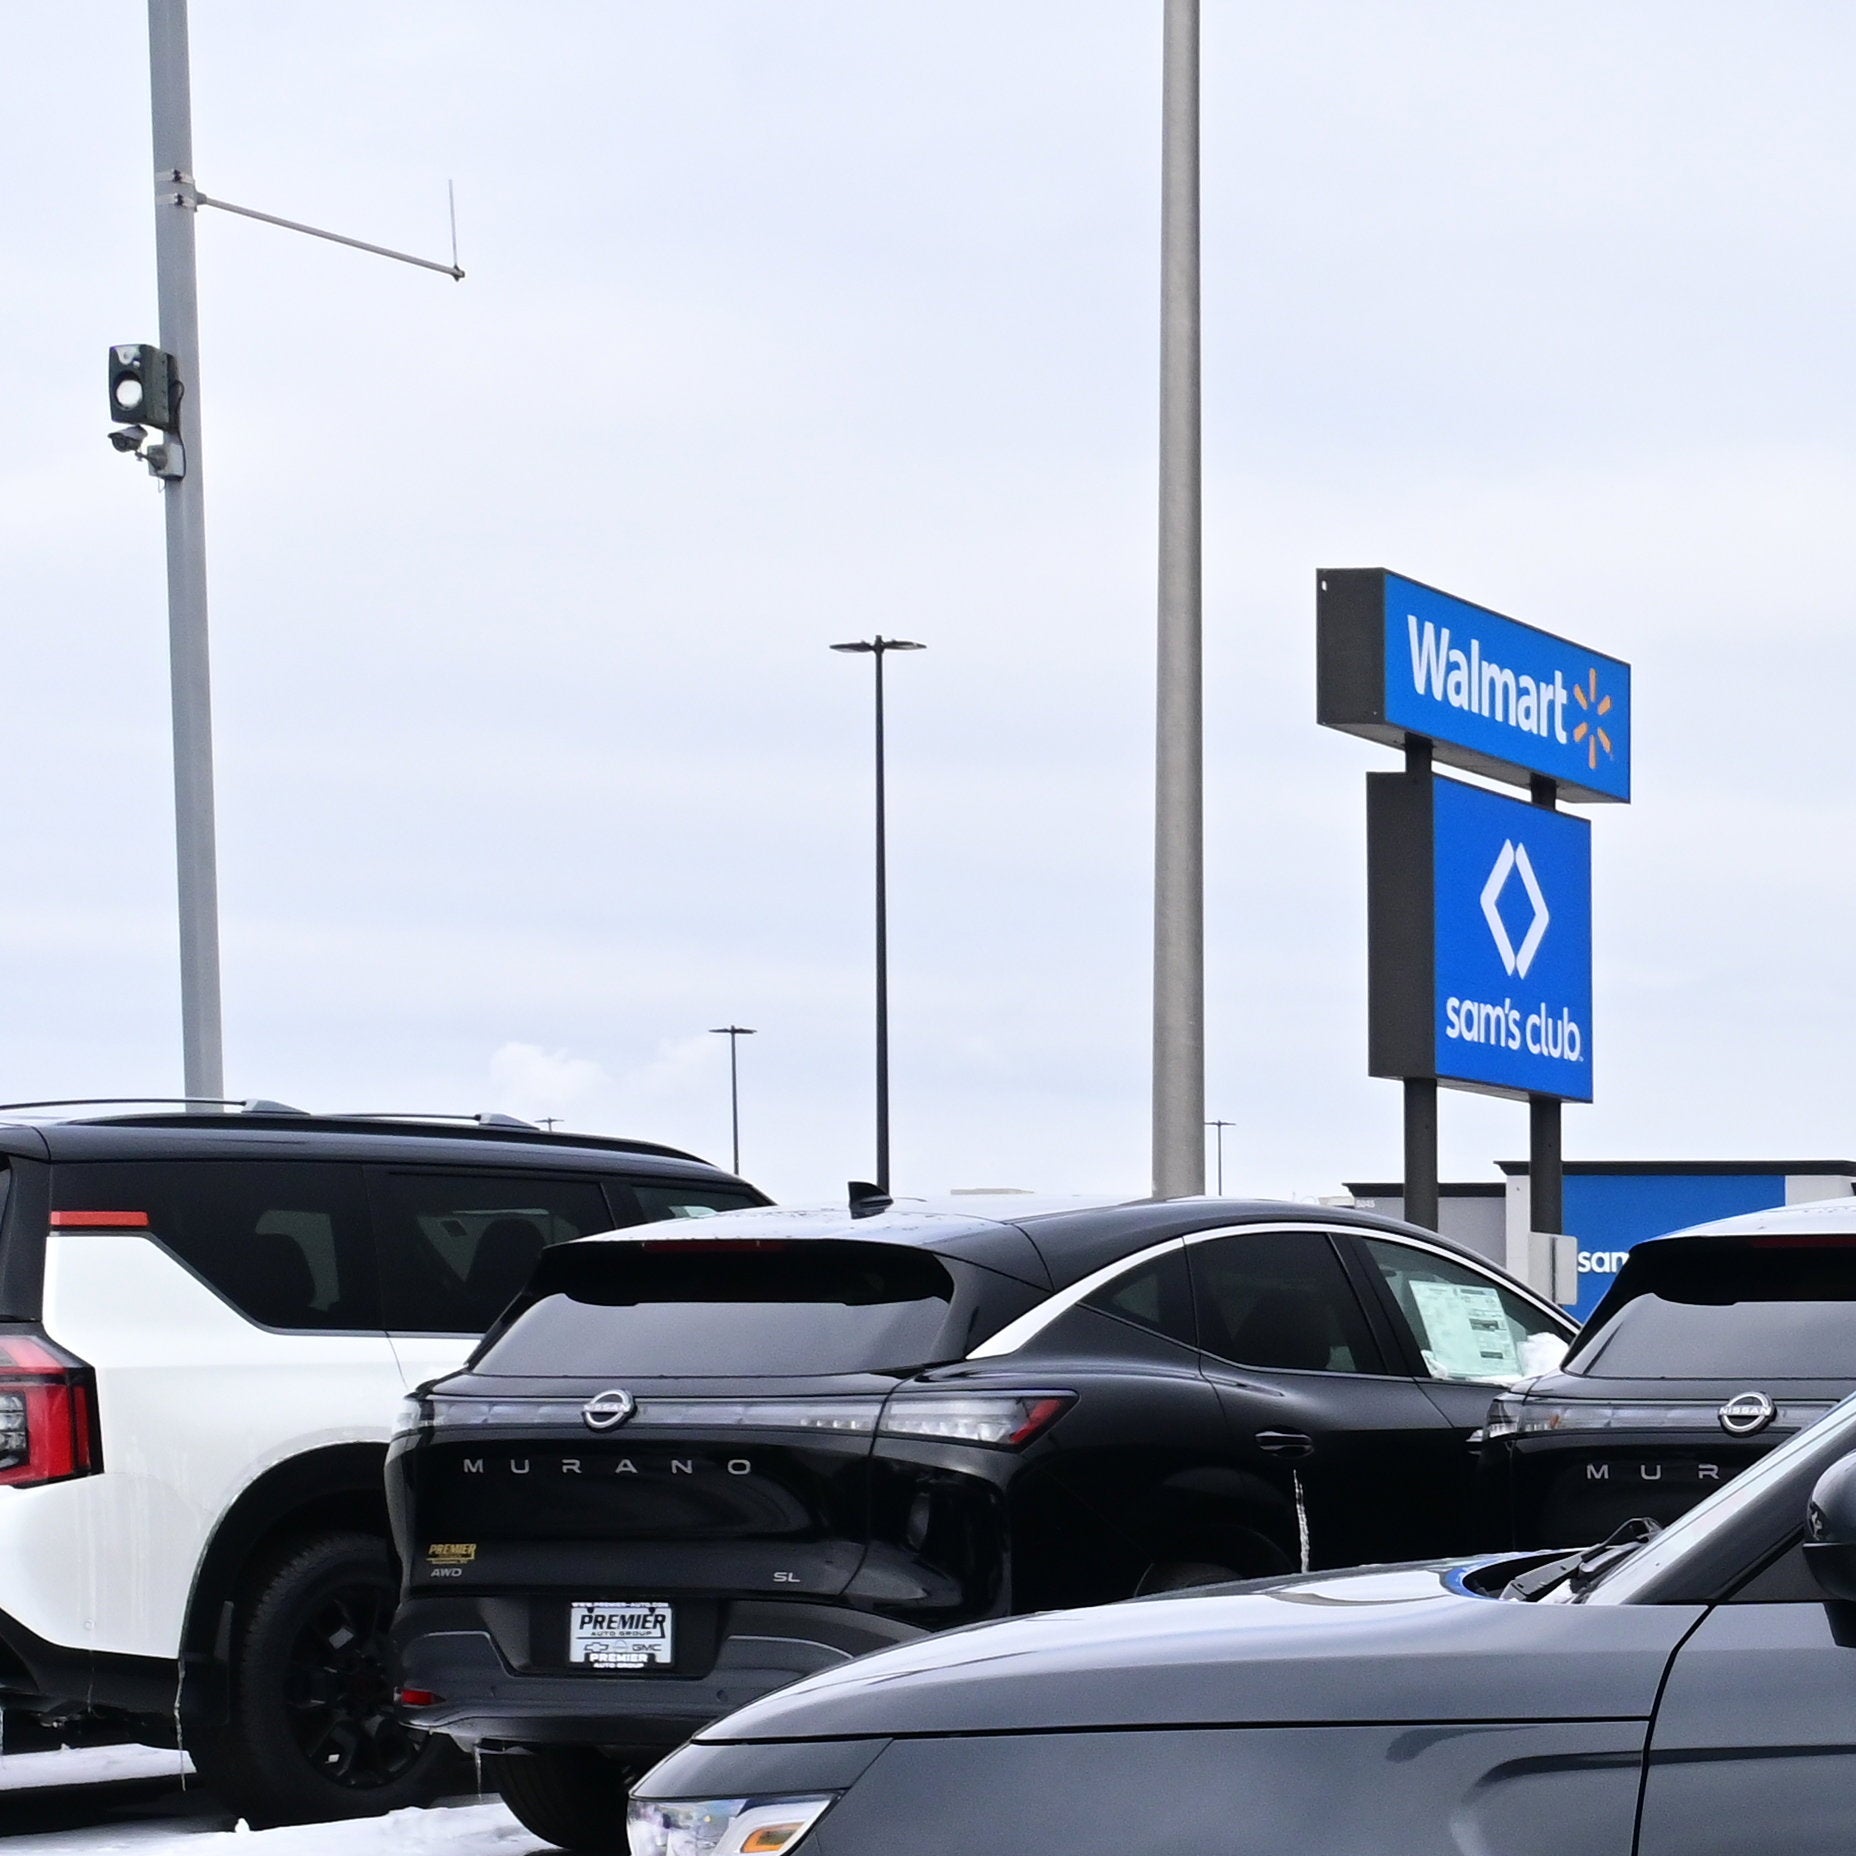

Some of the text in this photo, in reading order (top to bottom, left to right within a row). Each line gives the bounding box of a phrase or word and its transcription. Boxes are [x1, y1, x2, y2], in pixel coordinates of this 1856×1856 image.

[1407, 614, 1567, 744] Walmart
[1446, 997, 1581, 1061] sam's club
[1719, 1406, 1771, 1416] NISSAN
[463, 1458, 751, 1475] MURANO
[1587, 1463, 1720, 1480] MUR
[431, 1568, 462, 1577] AWD
[773, 1572, 801, 1583] SL
[579, 1614, 666, 1630] PREMIER
[632, 1643, 662, 1652] GMC
[590, 1653, 648, 1662] PREMIER
